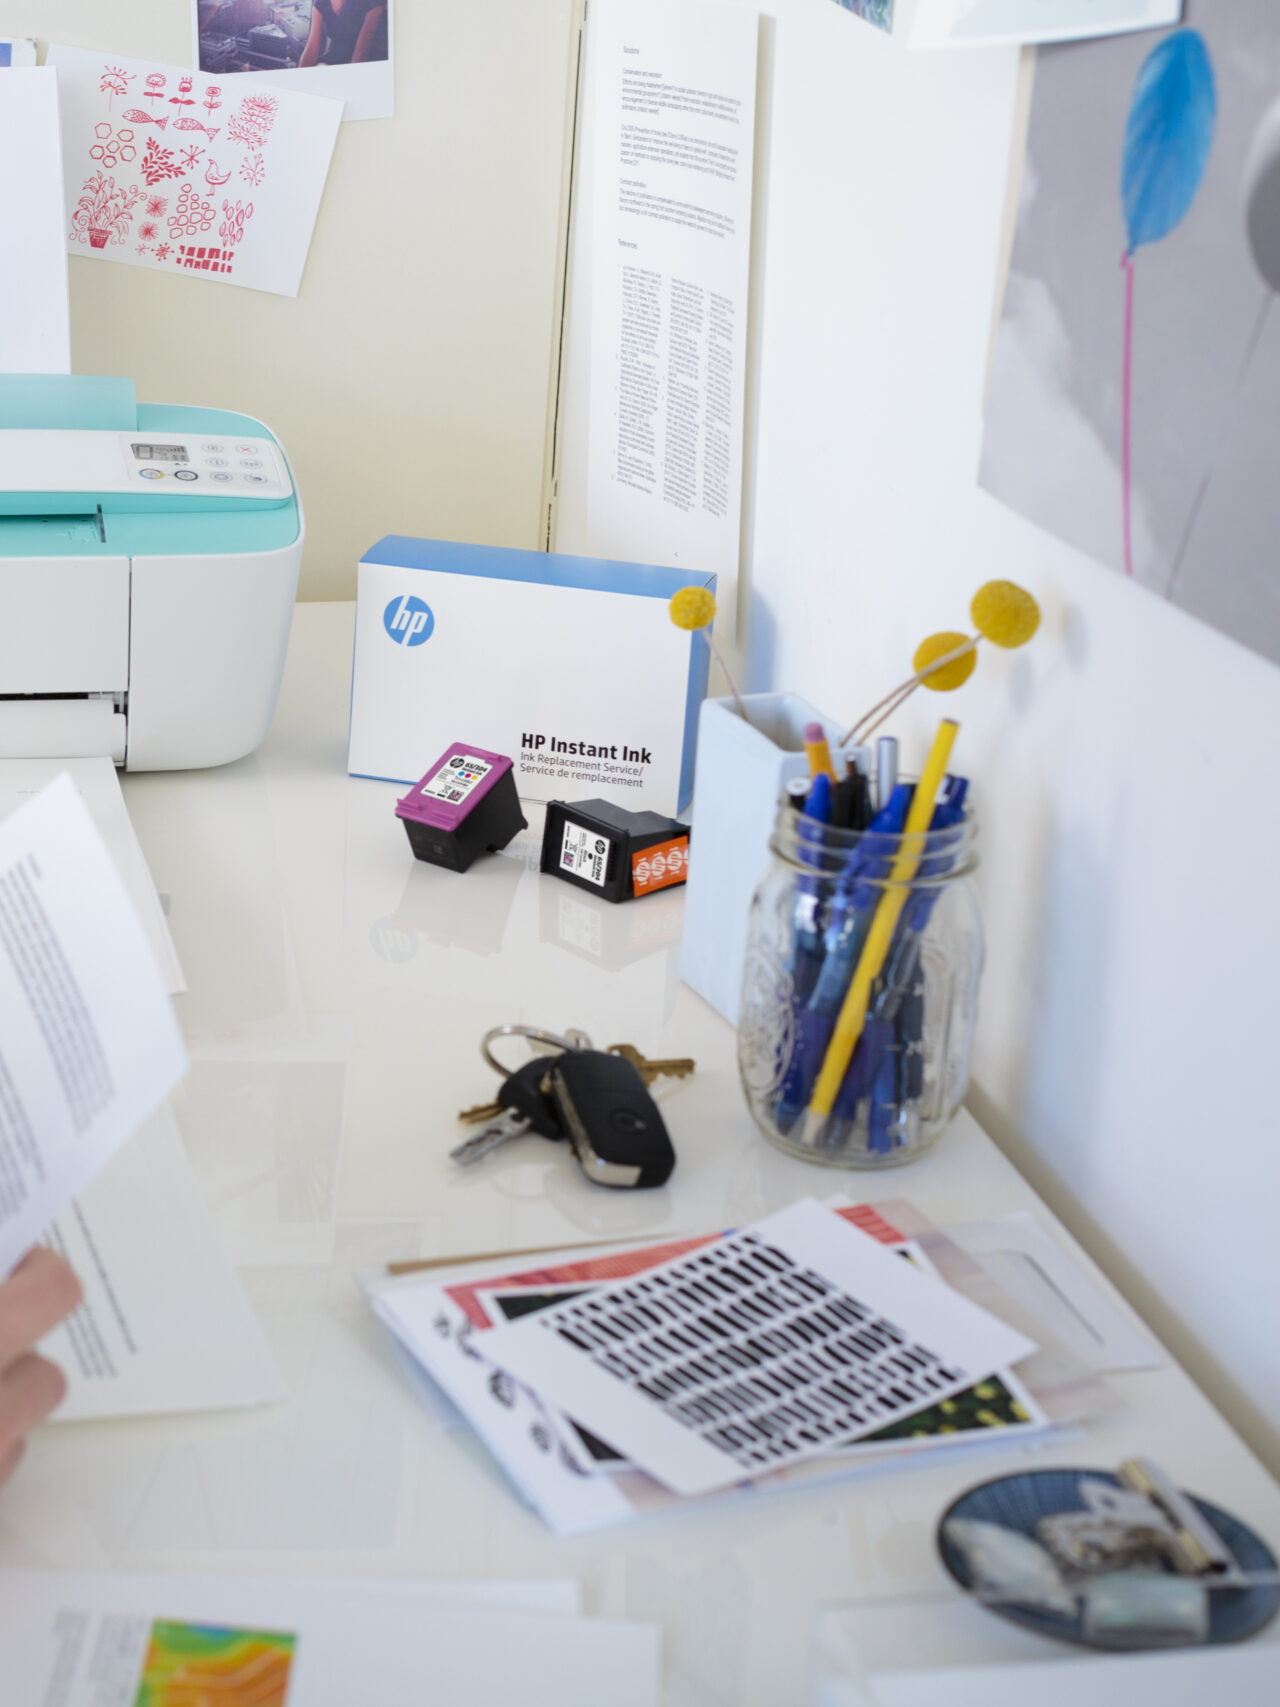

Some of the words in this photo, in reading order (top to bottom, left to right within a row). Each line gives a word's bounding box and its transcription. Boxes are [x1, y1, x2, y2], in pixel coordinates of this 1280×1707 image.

[385, 595, 432, 646] hp
[521, 732, 546, 750] HP
[551, 736, 618, 760] Instant
[623, 746, 652, 764] Ink
[520, 751, 535, 762] Ink
[537, 753, 601, 771] Replacement
[603, 763, 644, 777] Service/
[520, 763, 555, 777] Service
[557, 769, 569, 778] de
[571, 771, 644, 788] remplacement
